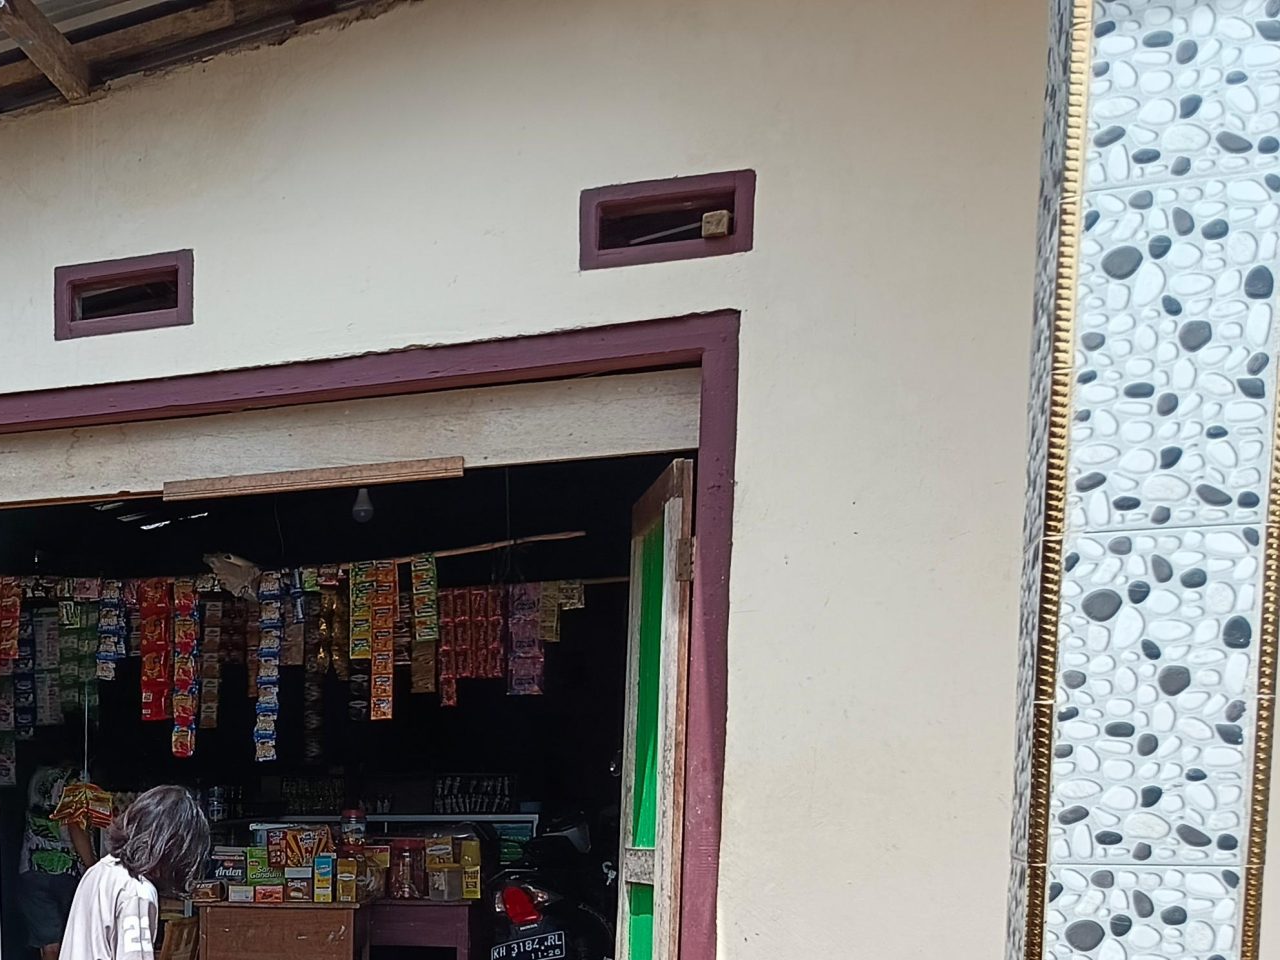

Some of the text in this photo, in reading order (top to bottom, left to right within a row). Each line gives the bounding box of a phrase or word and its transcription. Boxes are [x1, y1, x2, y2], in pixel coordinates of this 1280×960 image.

[215, 866, 242, 877] Arden
[250, 871, 282, 879] Gandum
[493, 934, 562, 959] KH 3184 RL
